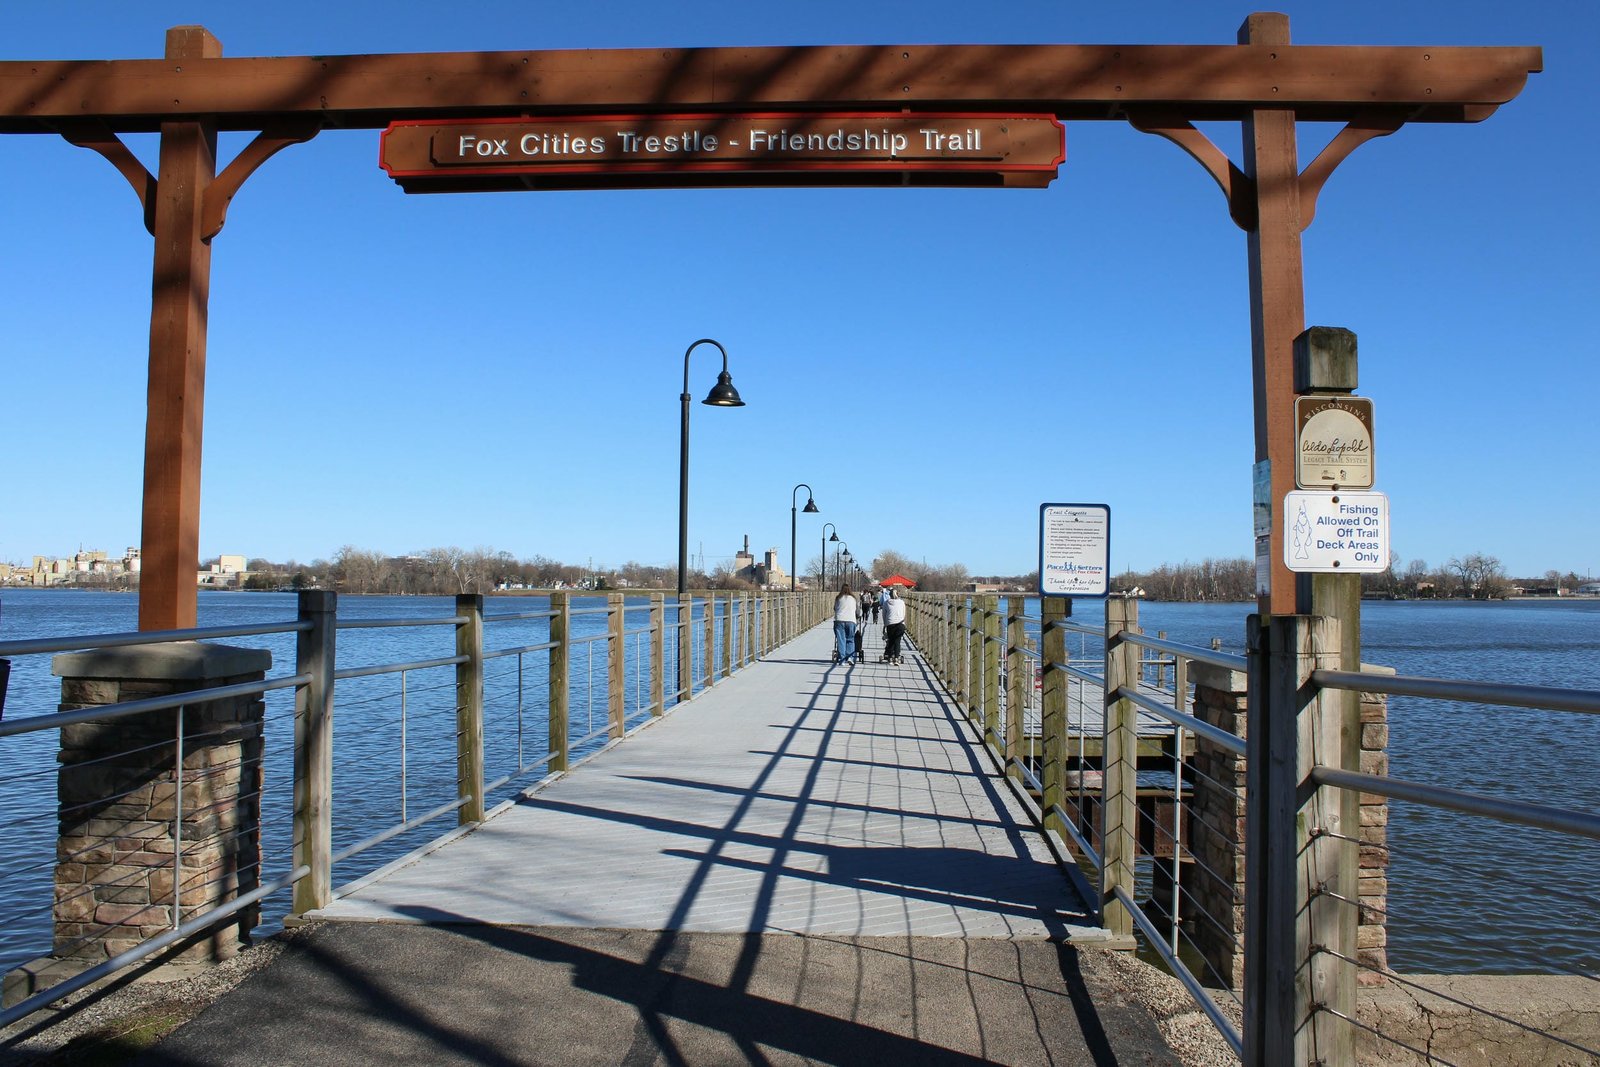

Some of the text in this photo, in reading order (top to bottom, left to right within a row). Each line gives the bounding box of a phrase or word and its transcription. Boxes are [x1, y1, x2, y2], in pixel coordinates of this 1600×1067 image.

[458, 134, 509, 157] Fox
[520, 132, 606, 155] Cities
[617, 129, 719, 153] Trestle
[750, 128, 909, 156] Friendship
[919, 128, 981, 150] Trail
[1304, 402, 1368, 421] WISCONSIN'S
[1302, 439, 1327, 452] Aldo
[1345, 456, 1368, 464] SYSTEM
[1339, 504, 1379, 516] Fishing
[1316, 516, 1379, 526] Allowed On
[1337, 528, 1379, 538] Off Trail
[1316, 540, 1379, 549] Deck Areas
[1354, 551, 1379, 563] Only
